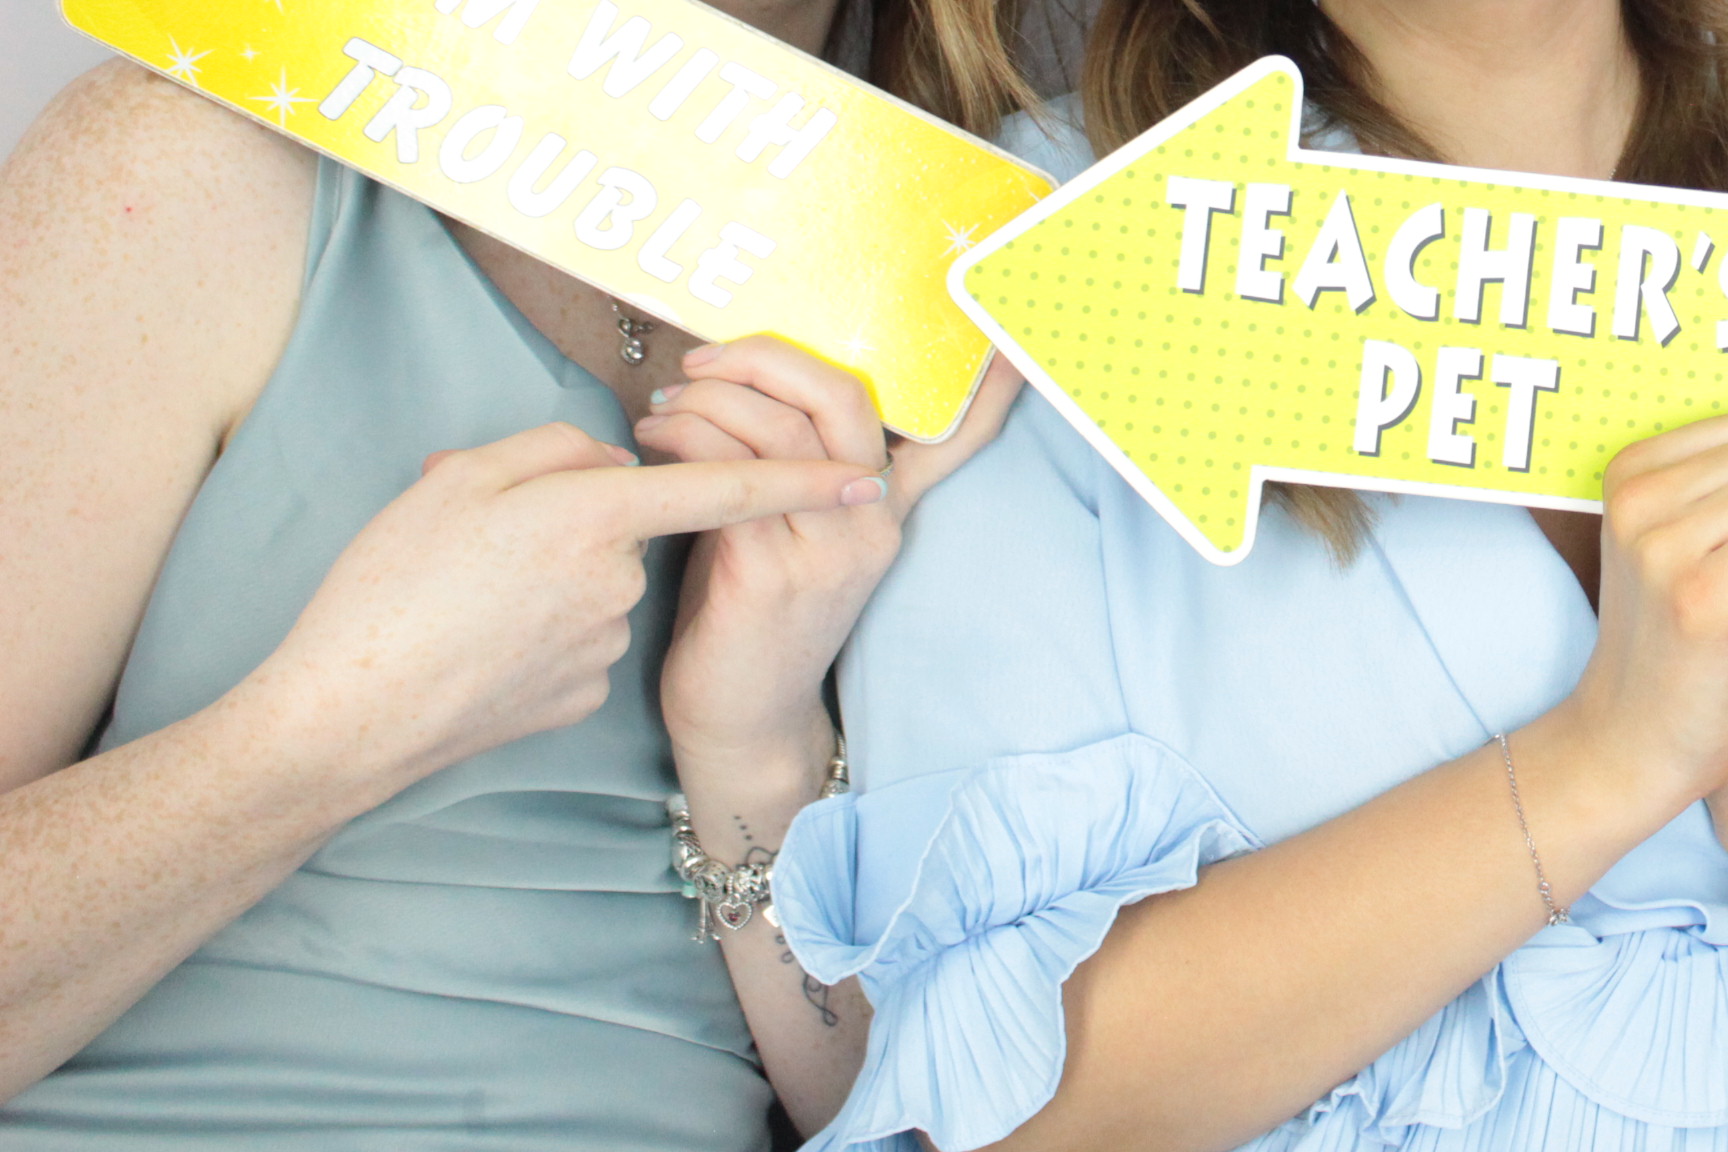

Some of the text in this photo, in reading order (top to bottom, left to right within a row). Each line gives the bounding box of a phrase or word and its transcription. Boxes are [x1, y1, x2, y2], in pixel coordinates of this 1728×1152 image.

[317, 36, 777, 308] TROUBLE
[565, 0, 839, 180] WITH
[1353, 339, 1560, 474] PET
